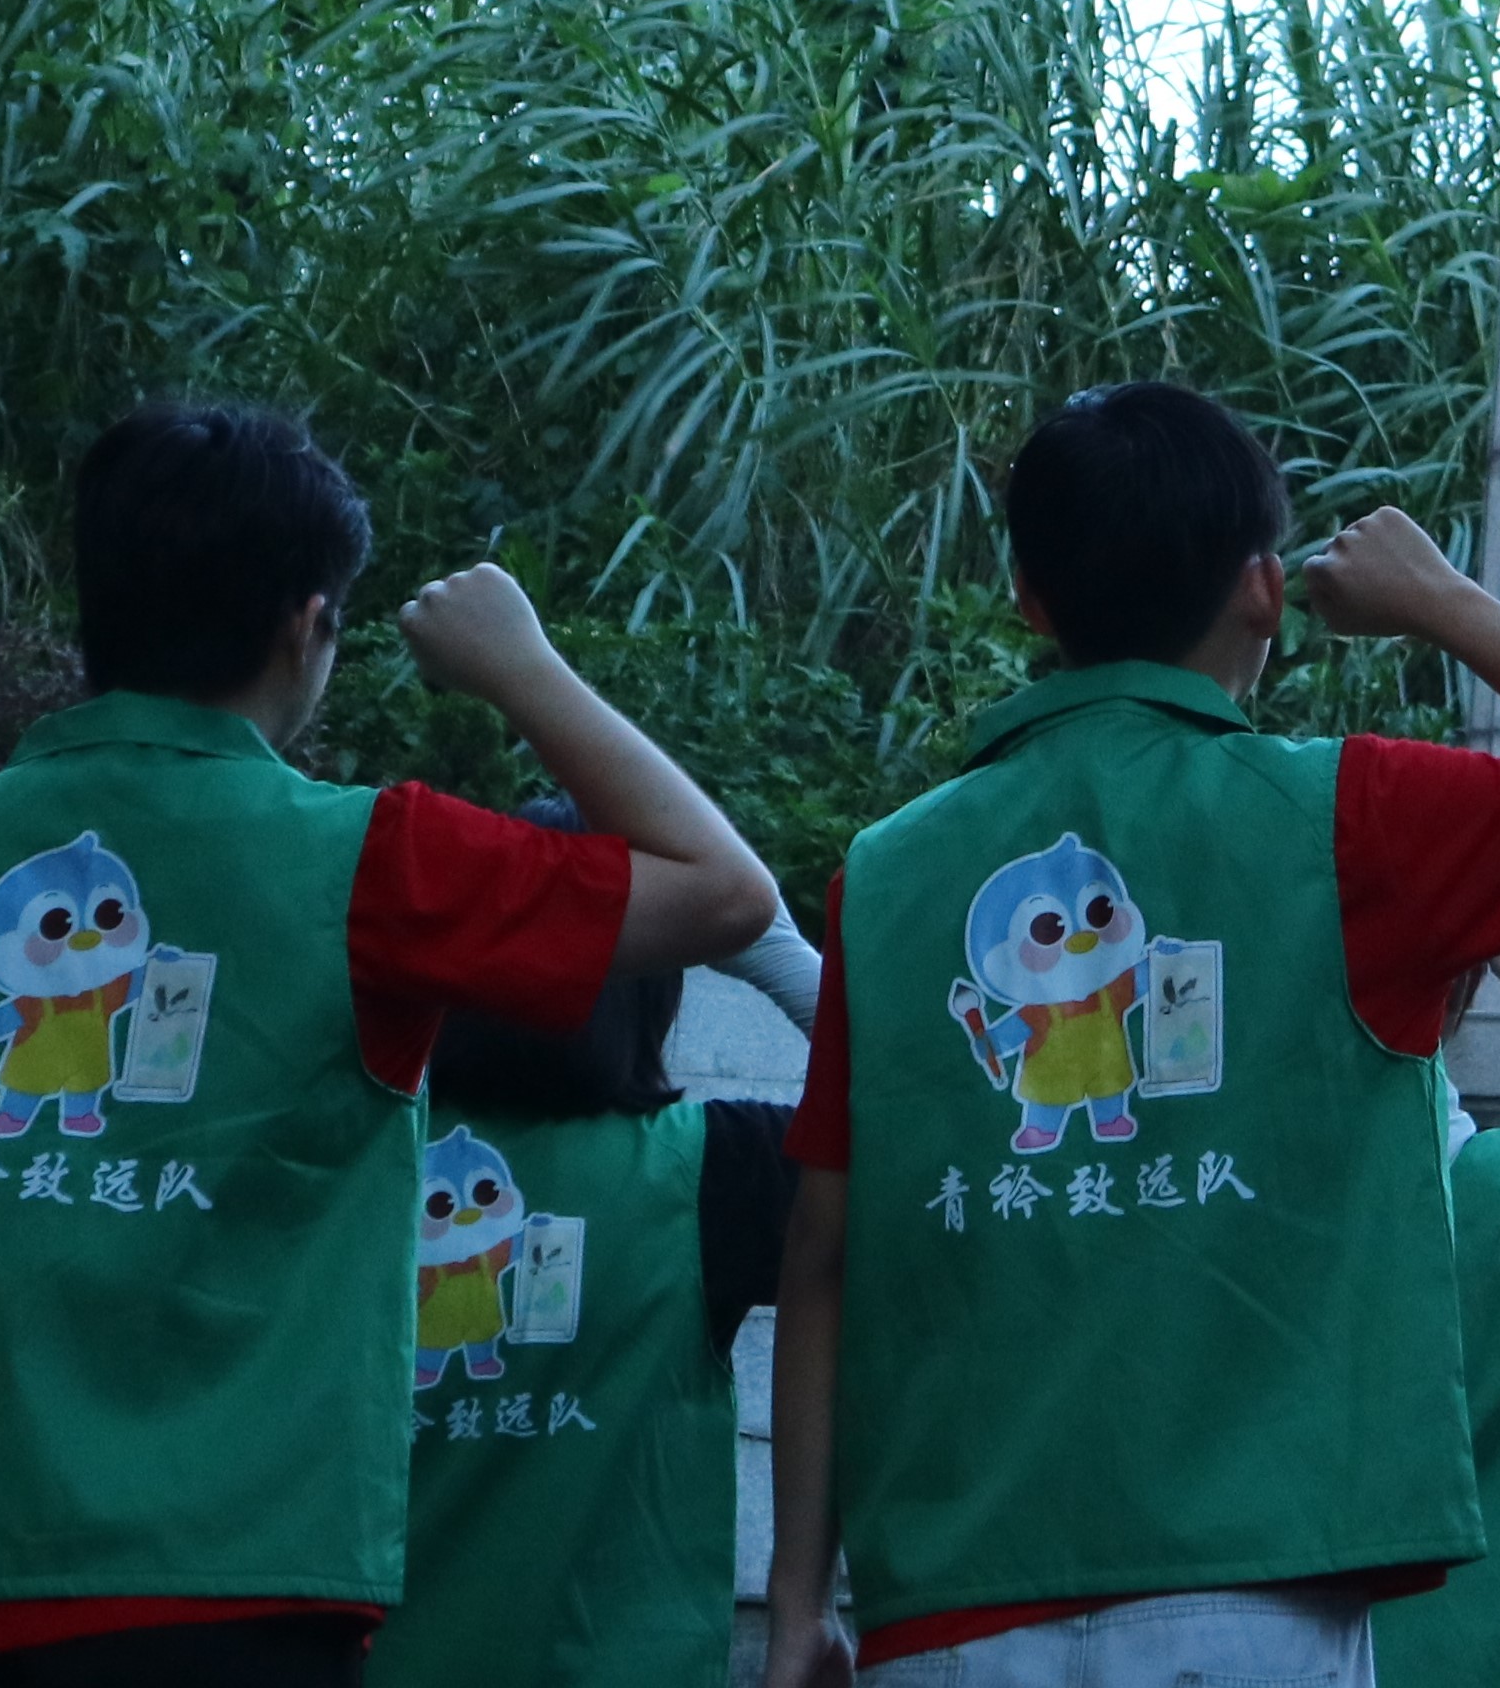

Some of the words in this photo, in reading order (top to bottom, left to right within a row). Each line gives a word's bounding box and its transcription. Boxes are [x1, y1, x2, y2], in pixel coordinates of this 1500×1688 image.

[925, 1150, 1255, 1234] 青衿致远队
